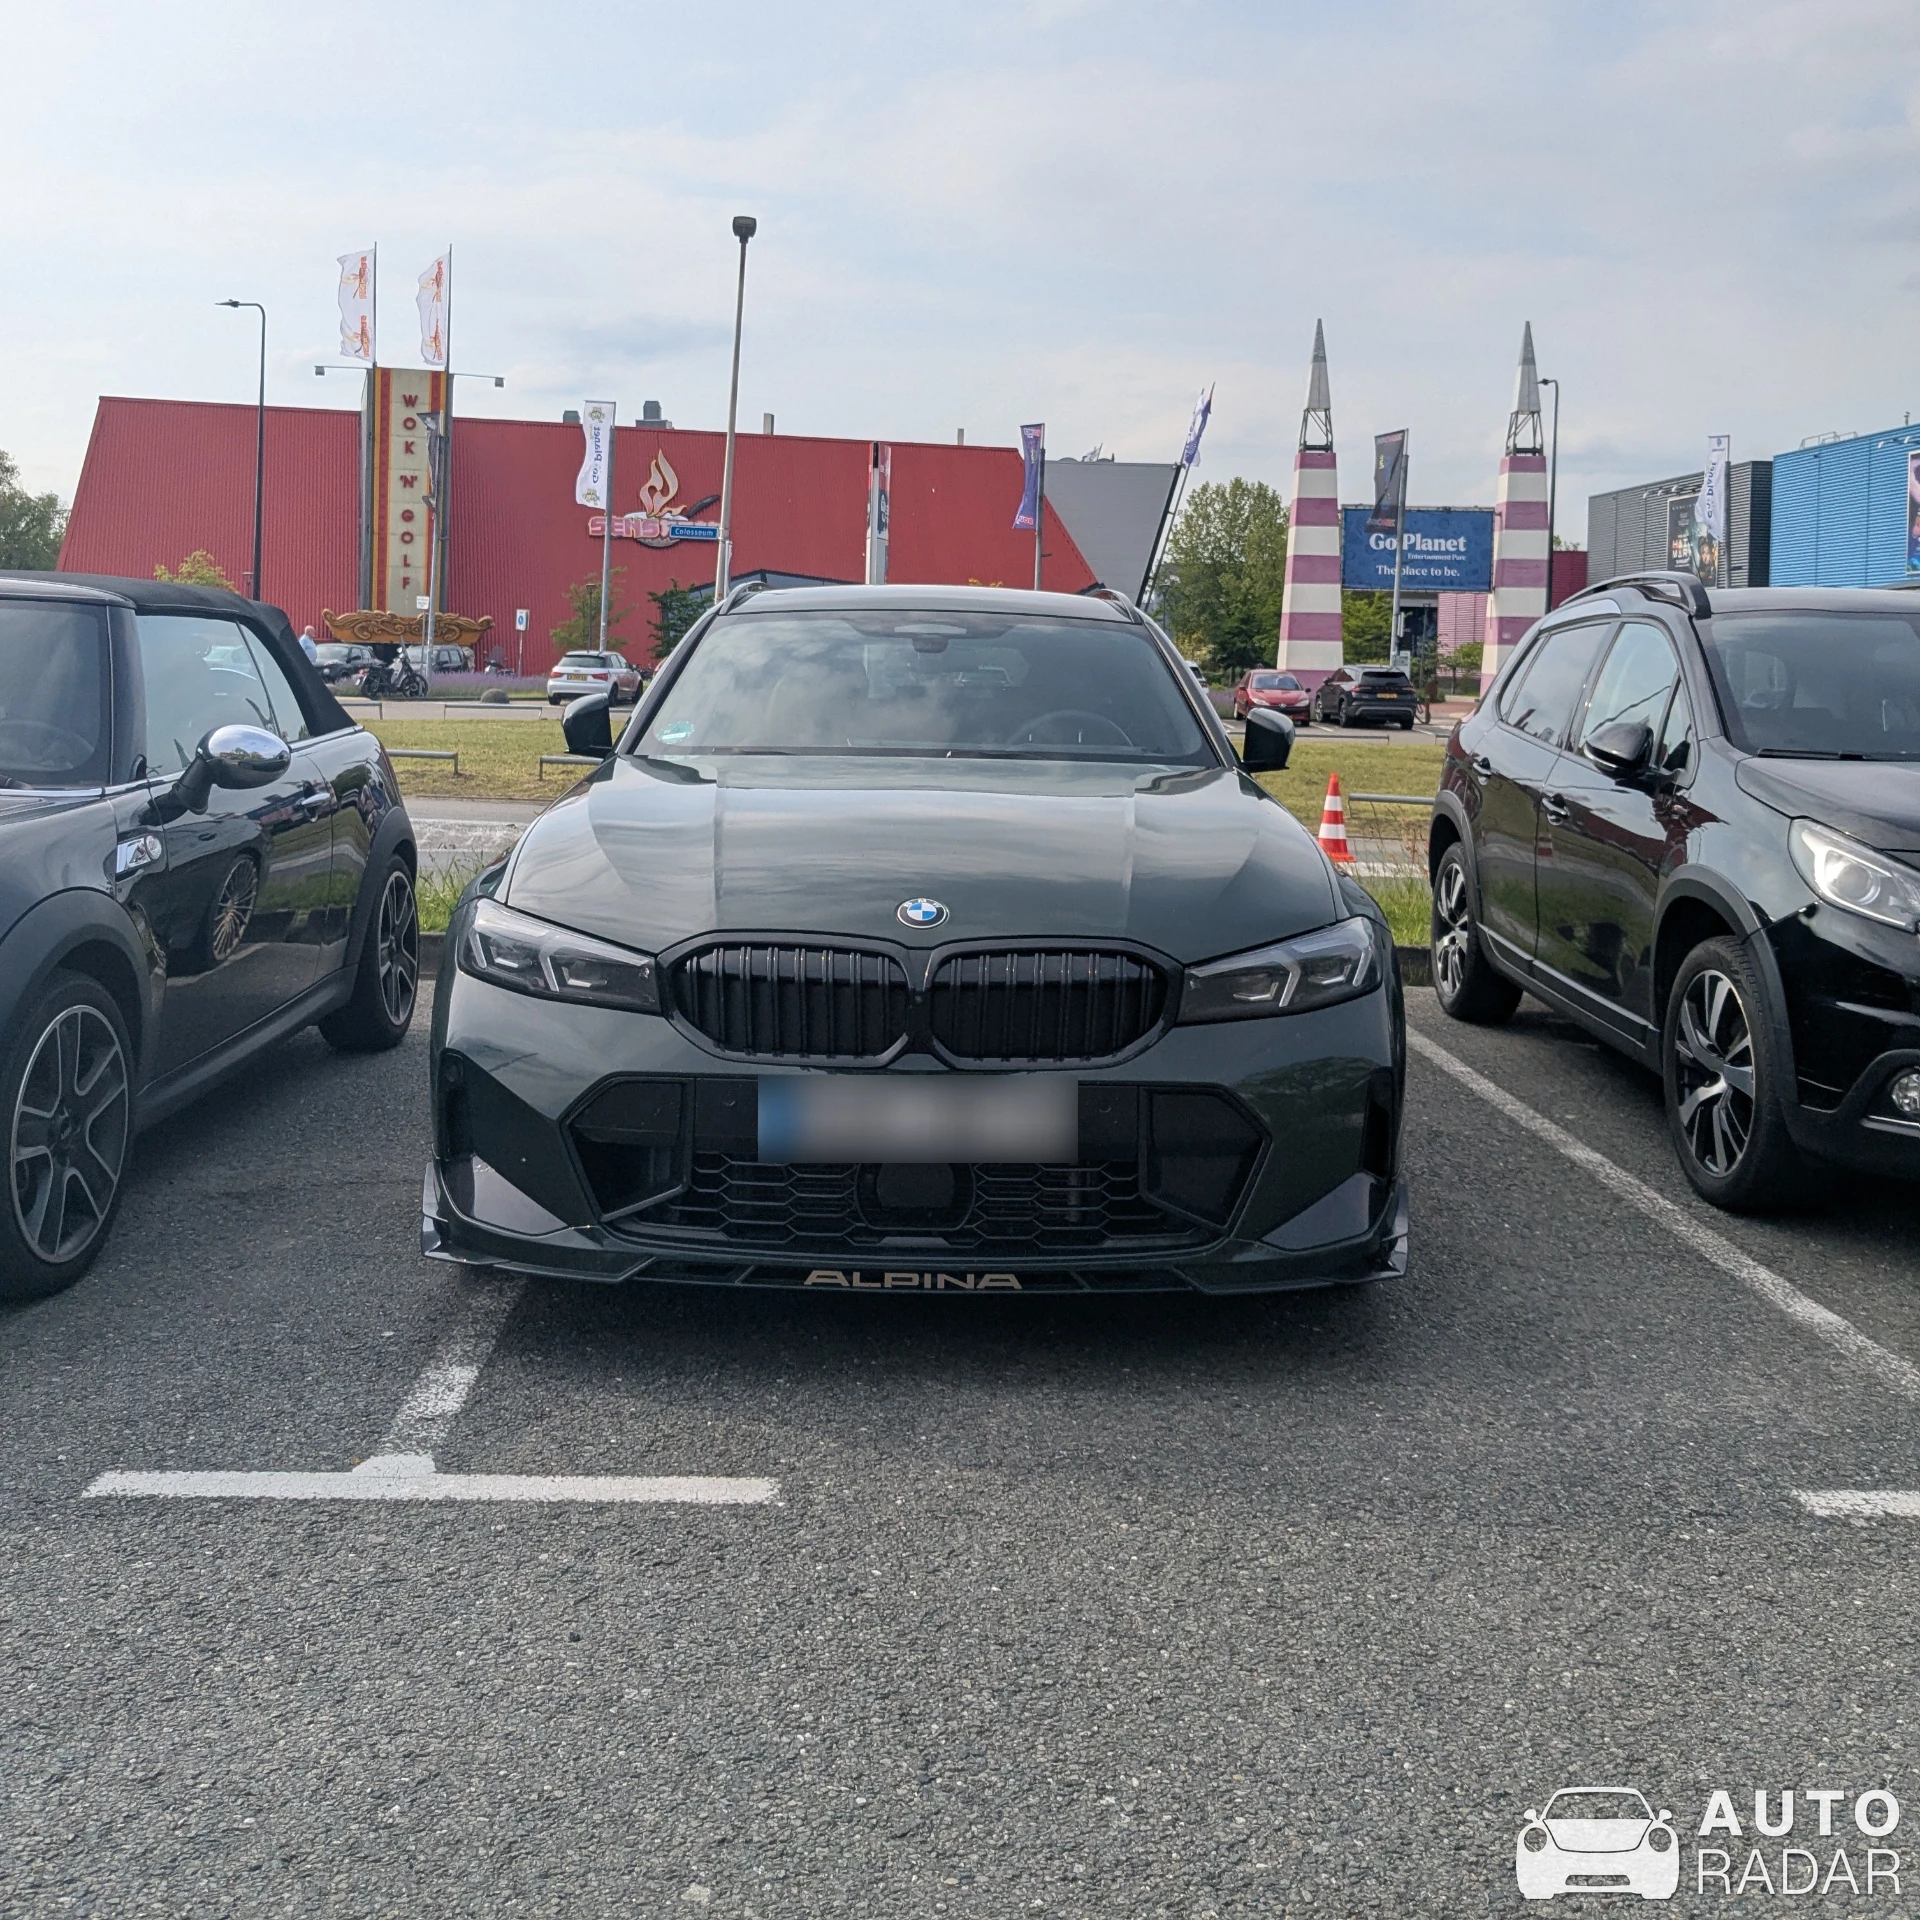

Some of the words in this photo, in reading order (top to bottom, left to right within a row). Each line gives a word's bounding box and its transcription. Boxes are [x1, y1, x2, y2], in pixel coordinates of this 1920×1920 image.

[402, 394, 418, 455] WOK
[674, 528, 714, 537] Colosseum
[401, 509, 415, 590] GOLF
[1369, 533, 1398, 551] Go
[1402, 533, 1467, 552] Planet
[1408, 553, 1451, 561] Entertainment
[1376, 565, 1396, 575] The
[1430, 567, 1442, 576] to
[1444, 566, 1460, 577] be.
[803, 1270, 1023, 1289] ALPINA
